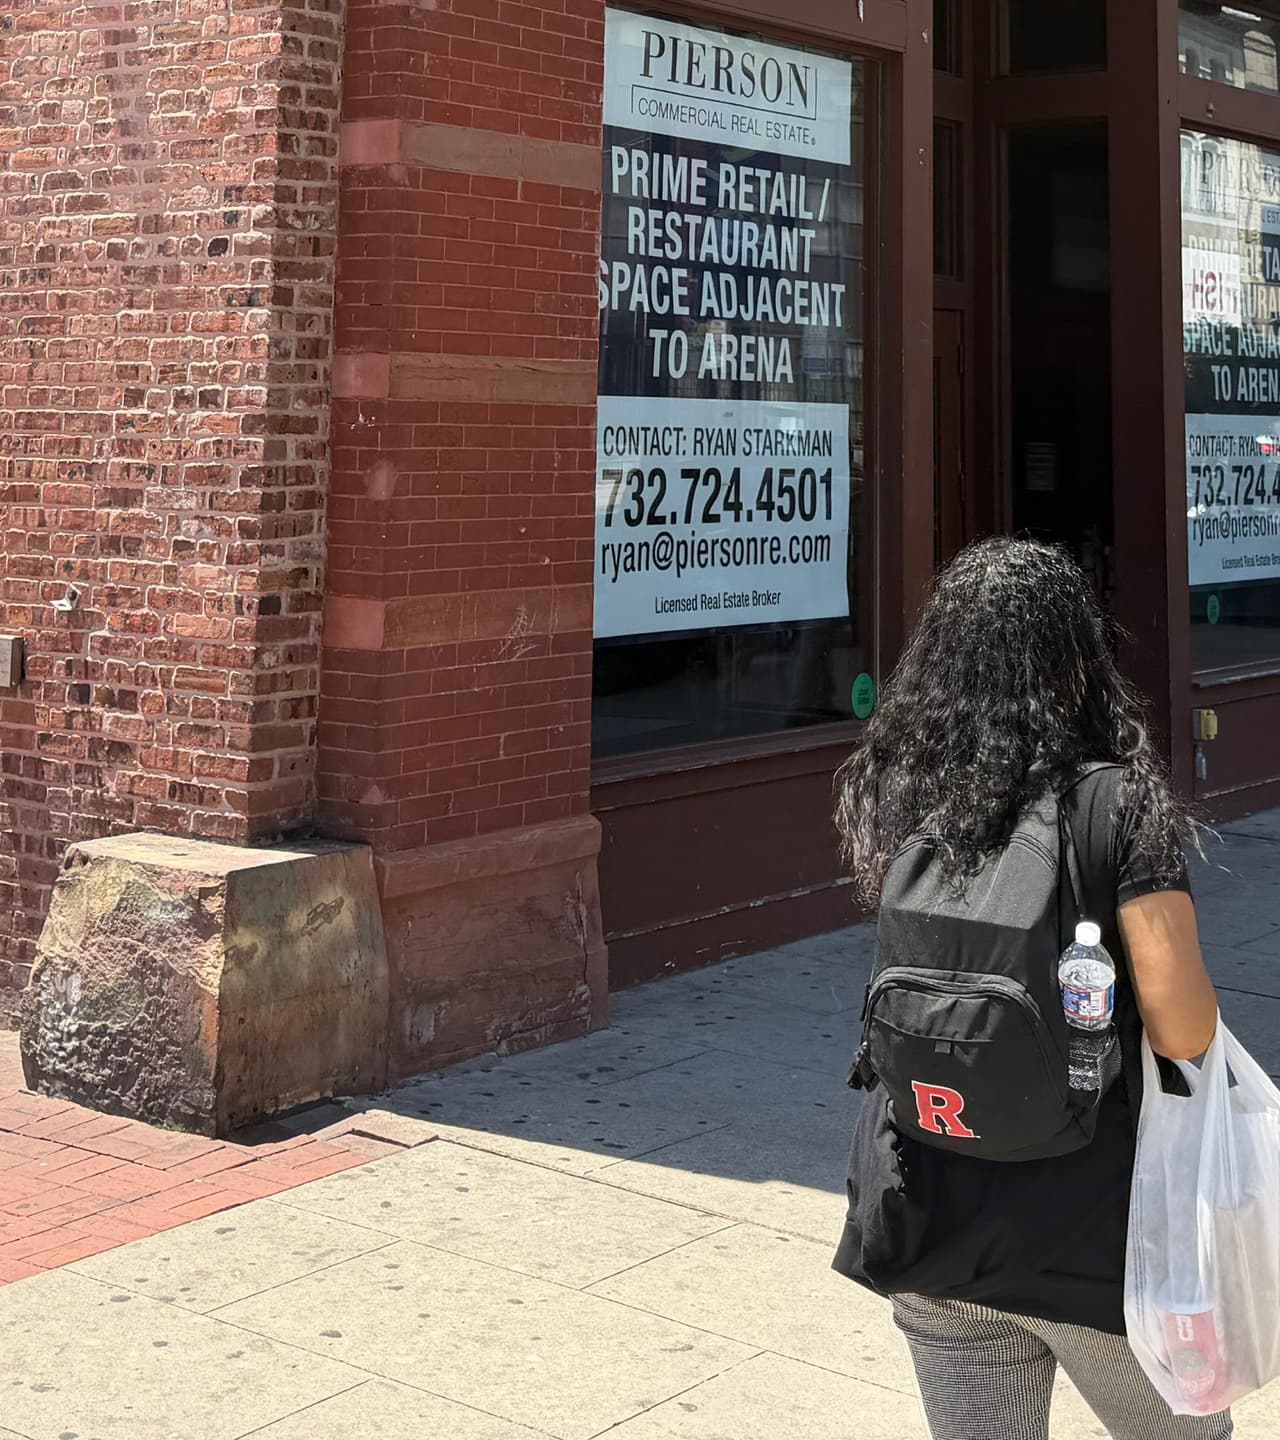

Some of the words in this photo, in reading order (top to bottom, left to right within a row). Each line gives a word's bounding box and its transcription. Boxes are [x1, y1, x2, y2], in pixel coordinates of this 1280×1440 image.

[639, 30, 810, 109] PIERSON
[638, 97, 727, 129] COMMERCIAL
[731, 114, 761, 136] REAL
[611, 145, 707, 207] PRIME
[628, 206, 816, 273] RESTAURANT
[598, 259, 689, 316] SPACE
[700, 271, 845, 328] ADJACENT
[649, 329, 689, 379] TO
[698, 332, 794, 384] ARENA
[1211, 365, 1231, 401] TO
[603, 426, 687, 456] CONTACT:
[693, 427, 737, 457] RYAN
[742, 428, 832, 457] STARKMAN
[1189, 434, 1236, 456] CONTACT:
[601, 466, 832, 527] 732.724.4501
[601, 530, 831, 583] ryan@piersonre.com
[655, 594, 698, 614] Licensed
[701, 592, 720, 610] Real
[723, 592, 750, 610] Estate
[752, 589, 781, 606] Broker
[911, 1080, 979, 1138] R
